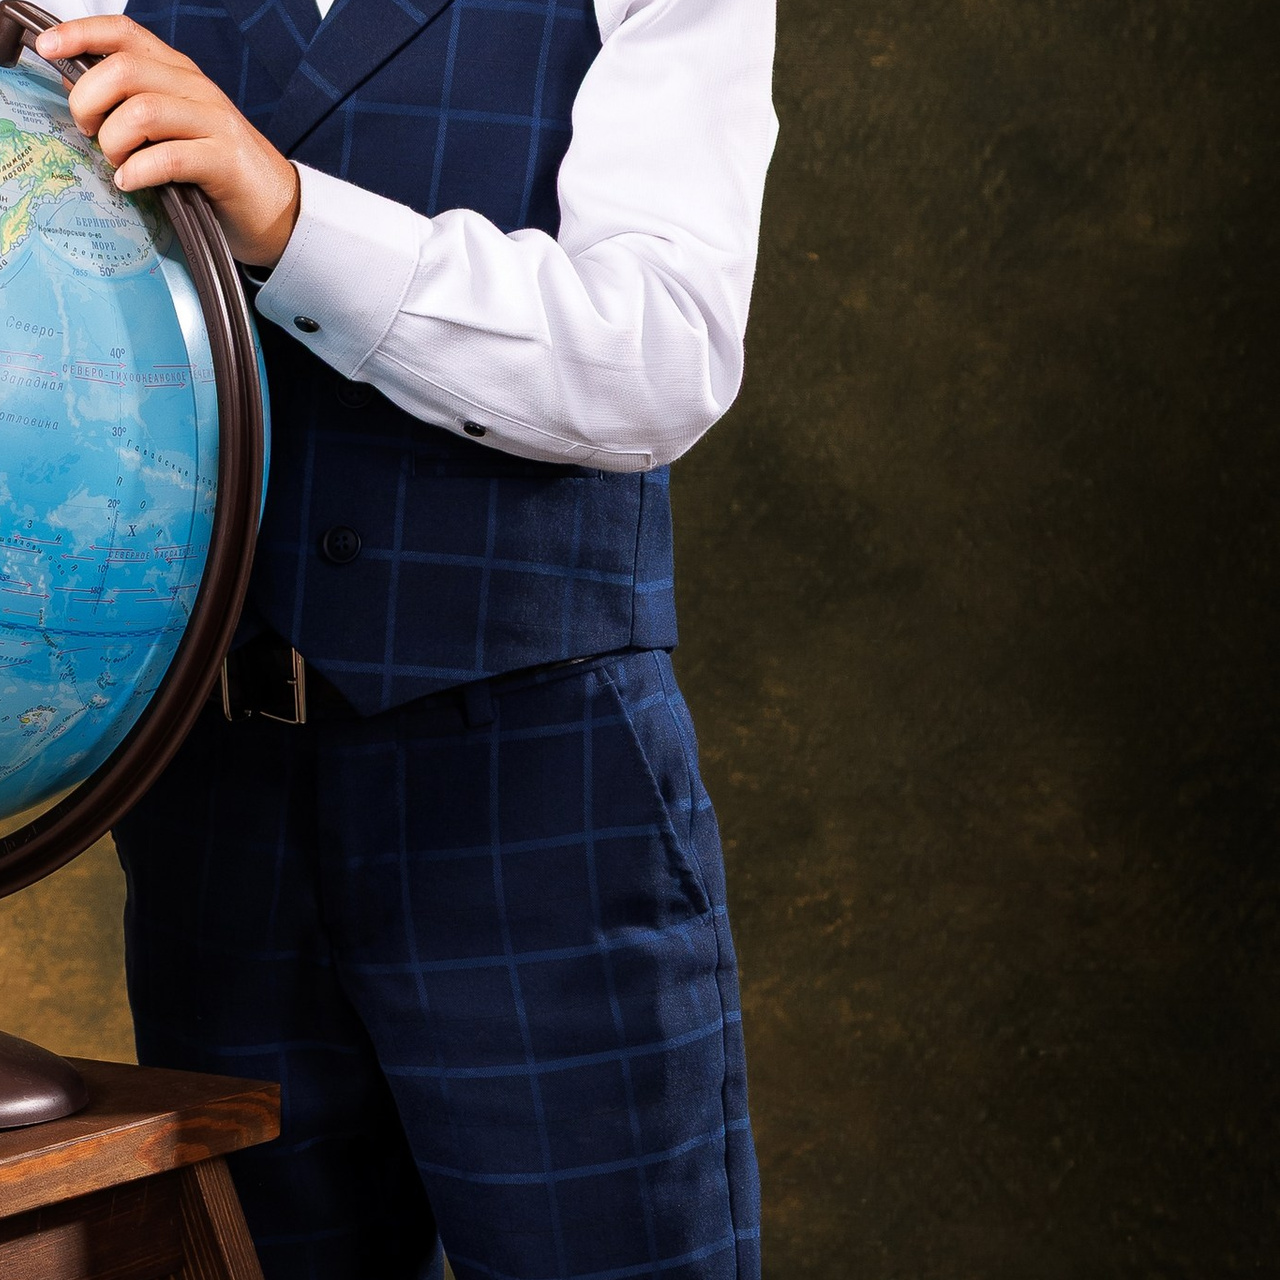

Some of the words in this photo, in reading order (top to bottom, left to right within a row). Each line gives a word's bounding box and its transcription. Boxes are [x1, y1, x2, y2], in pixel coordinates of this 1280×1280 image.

[91, 240, 117, 252] МОРЕ
[110, 347, 126, 359] 40°
[111, 426, 127, 437] 30°
[107, 498, 120, 509] 20°
